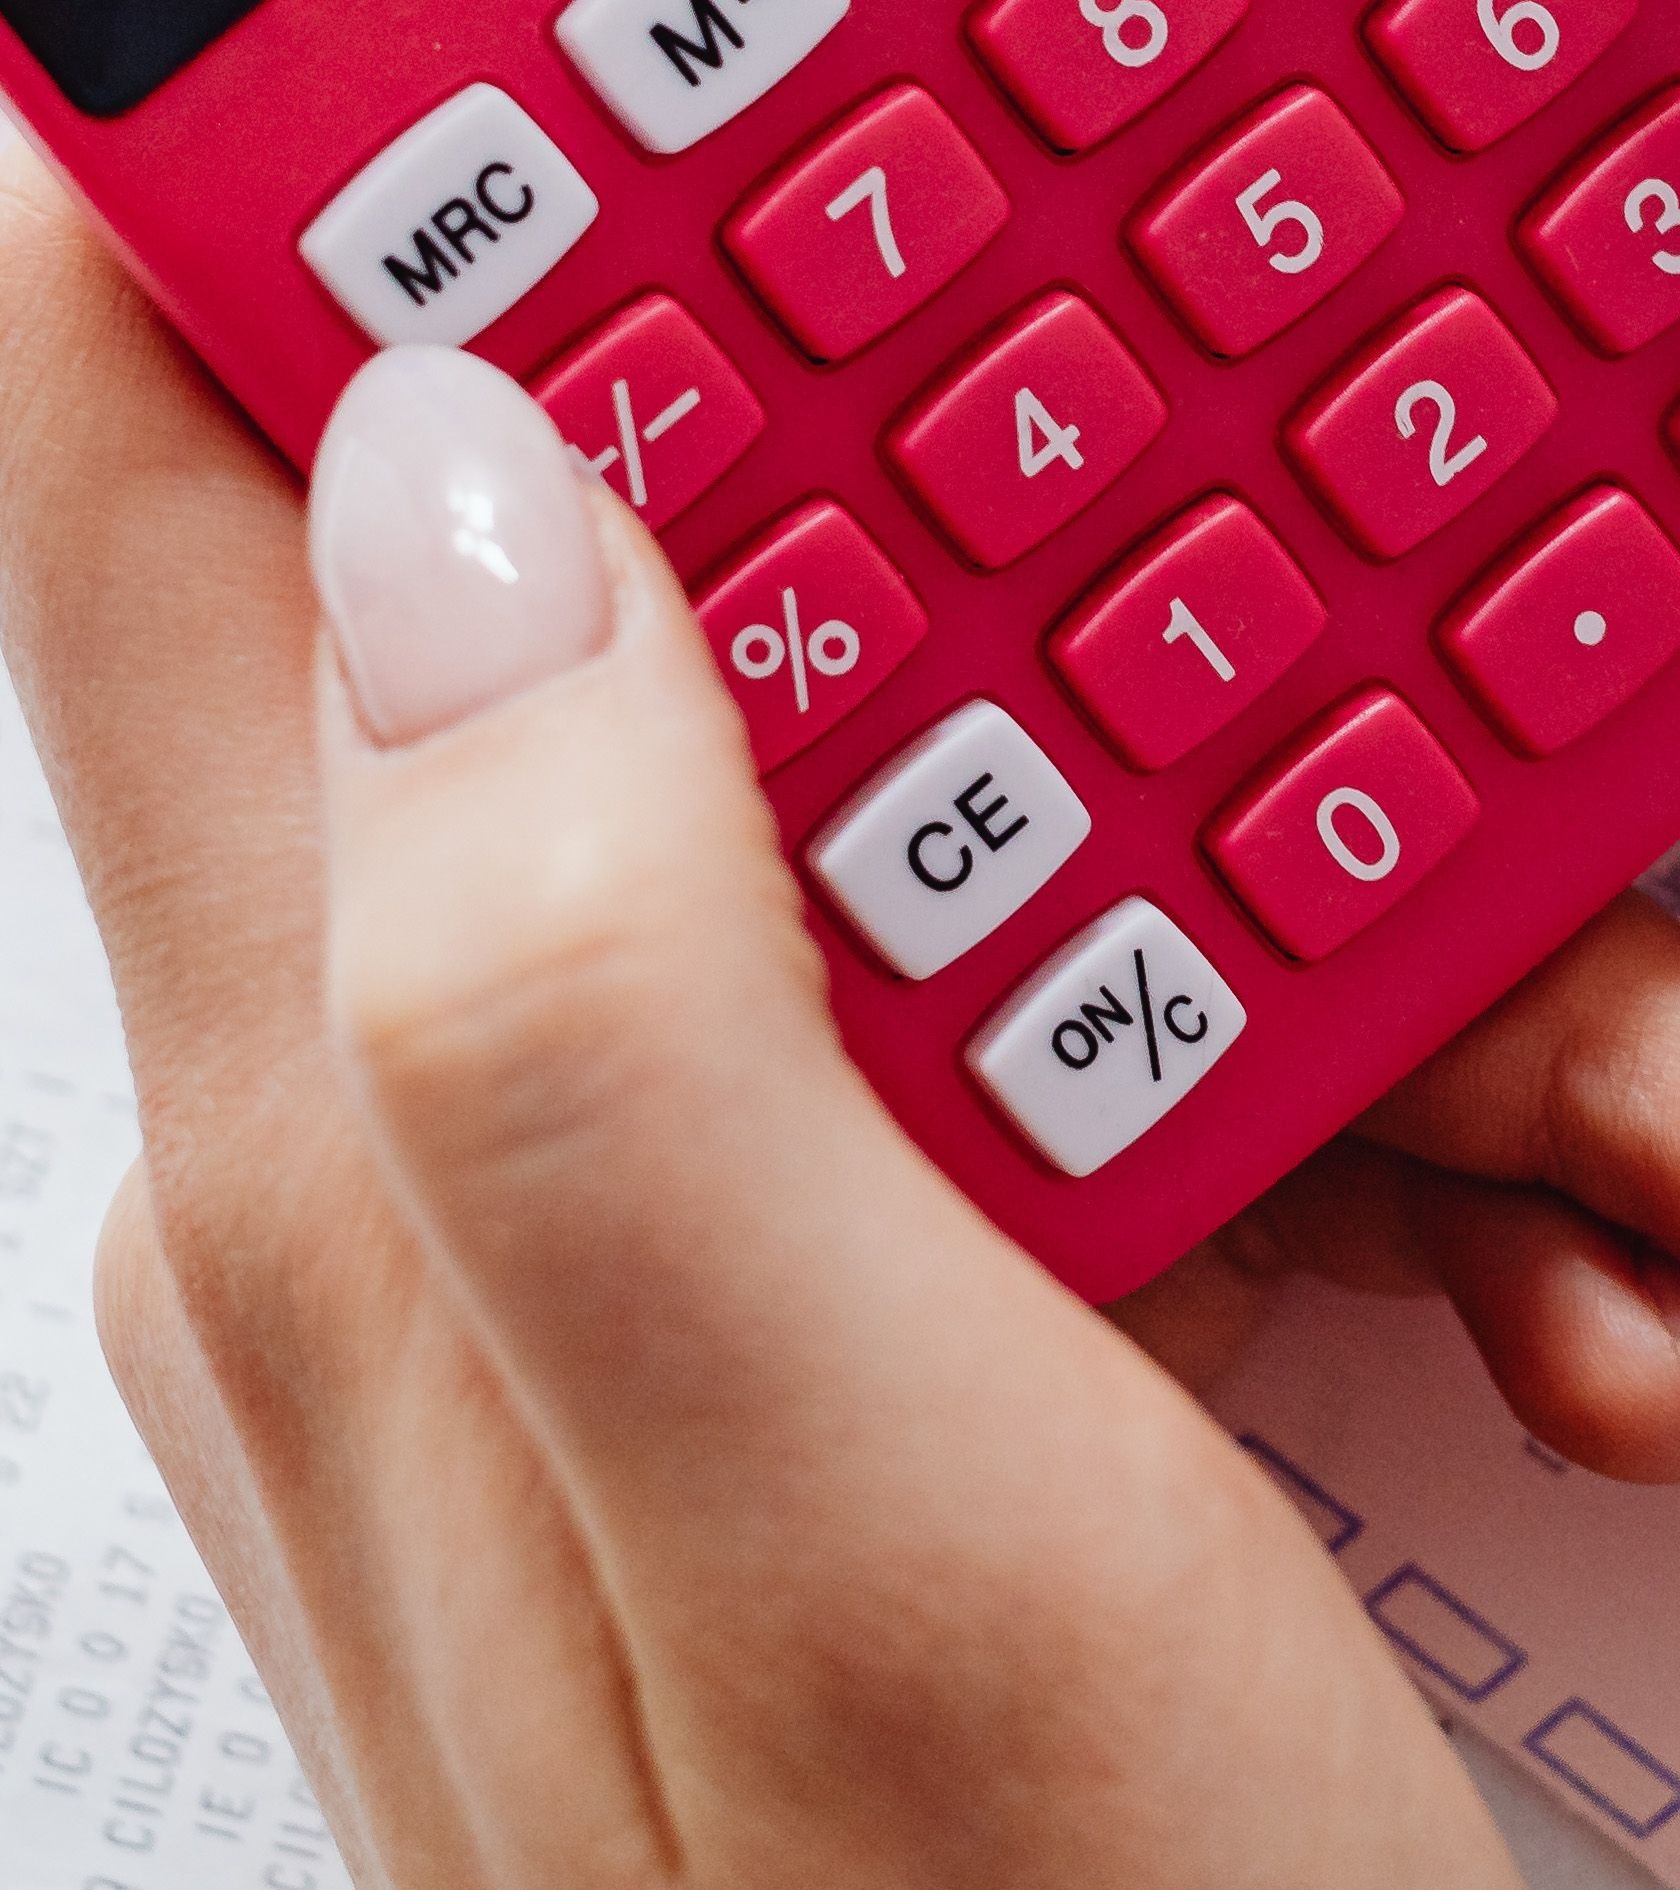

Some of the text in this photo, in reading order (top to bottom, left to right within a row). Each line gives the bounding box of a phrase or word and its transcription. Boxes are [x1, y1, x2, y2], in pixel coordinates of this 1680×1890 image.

[382, 162, 535, 306] MRC
[826, 167, 906, 278] 7
[1235, 168, 1324, 274] 5
[1015, 387, 1084, 477] 4
[1394, 380, 1488, 486] 2
[1162, 597, 1236, 682] 1
[907, 772, 1030, 893] CE
[1316, 787, 1400, 881] 0
[1051, 948, 1209, 1083] ON/C
